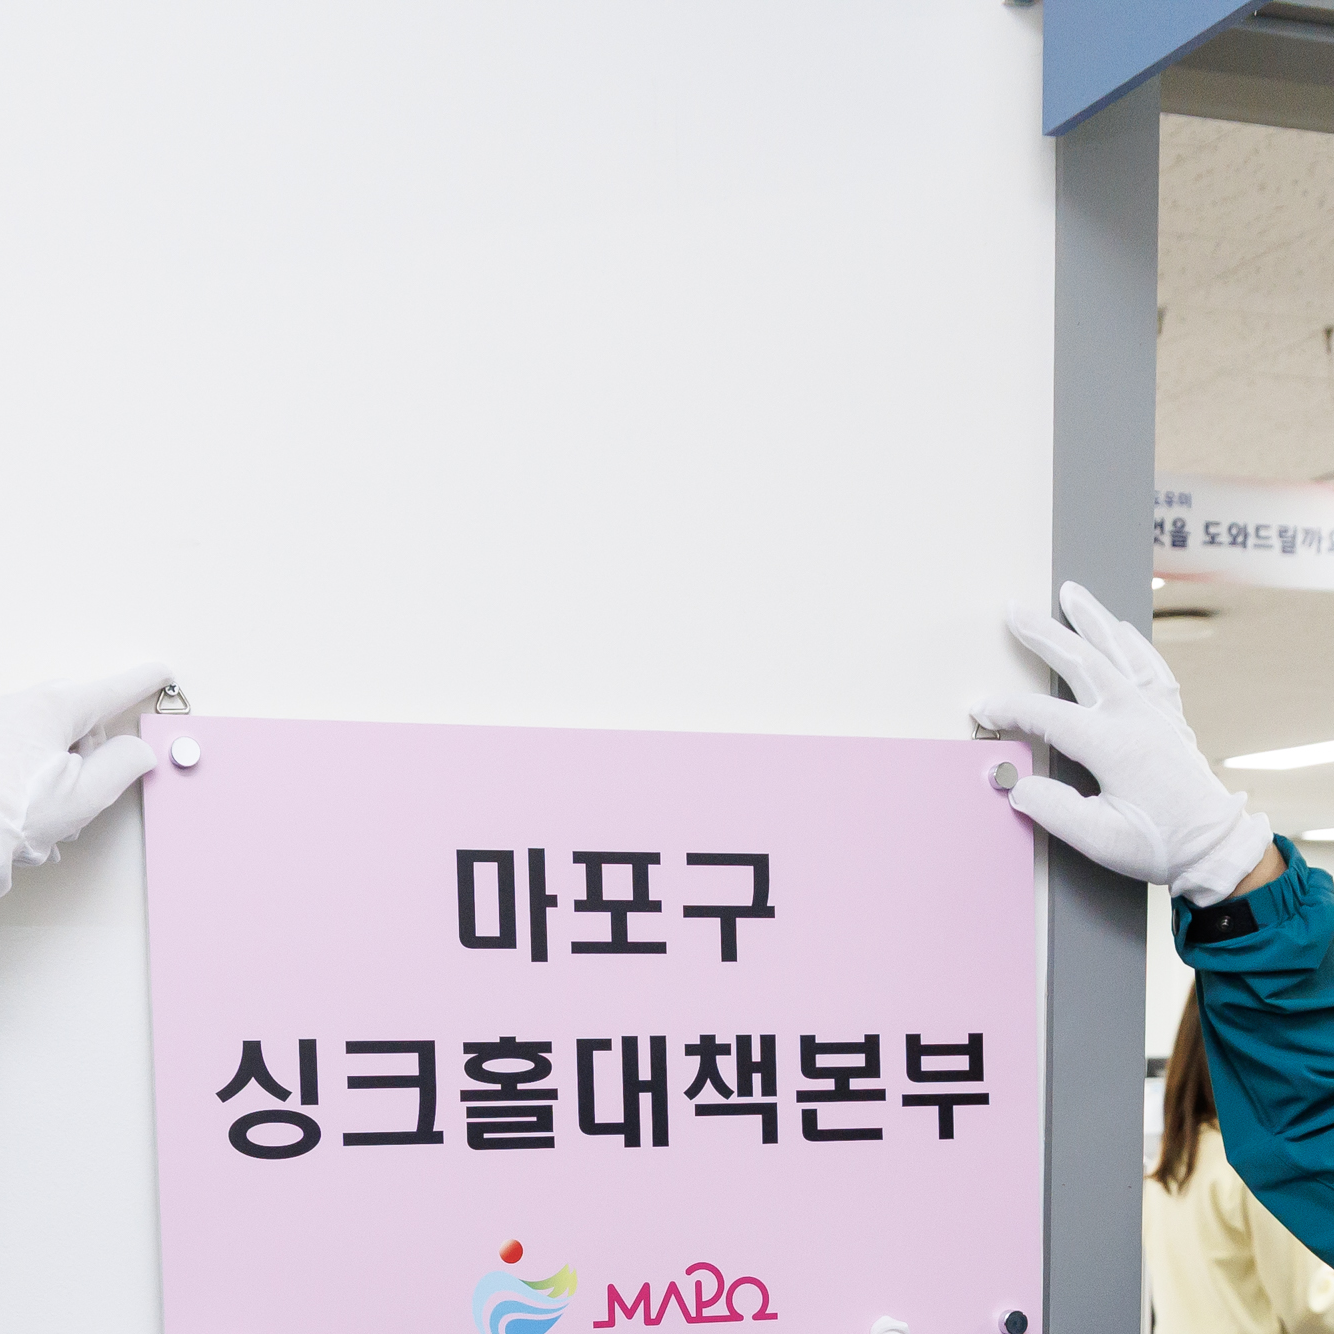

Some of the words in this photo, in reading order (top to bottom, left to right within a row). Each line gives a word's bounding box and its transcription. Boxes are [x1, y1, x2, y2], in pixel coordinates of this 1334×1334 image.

[455, 847, 777, 963] 마포구
[214, 1031, 991, 1160] 싱크홀대책본부
[592, 1261, 779, 1329] MAPO
